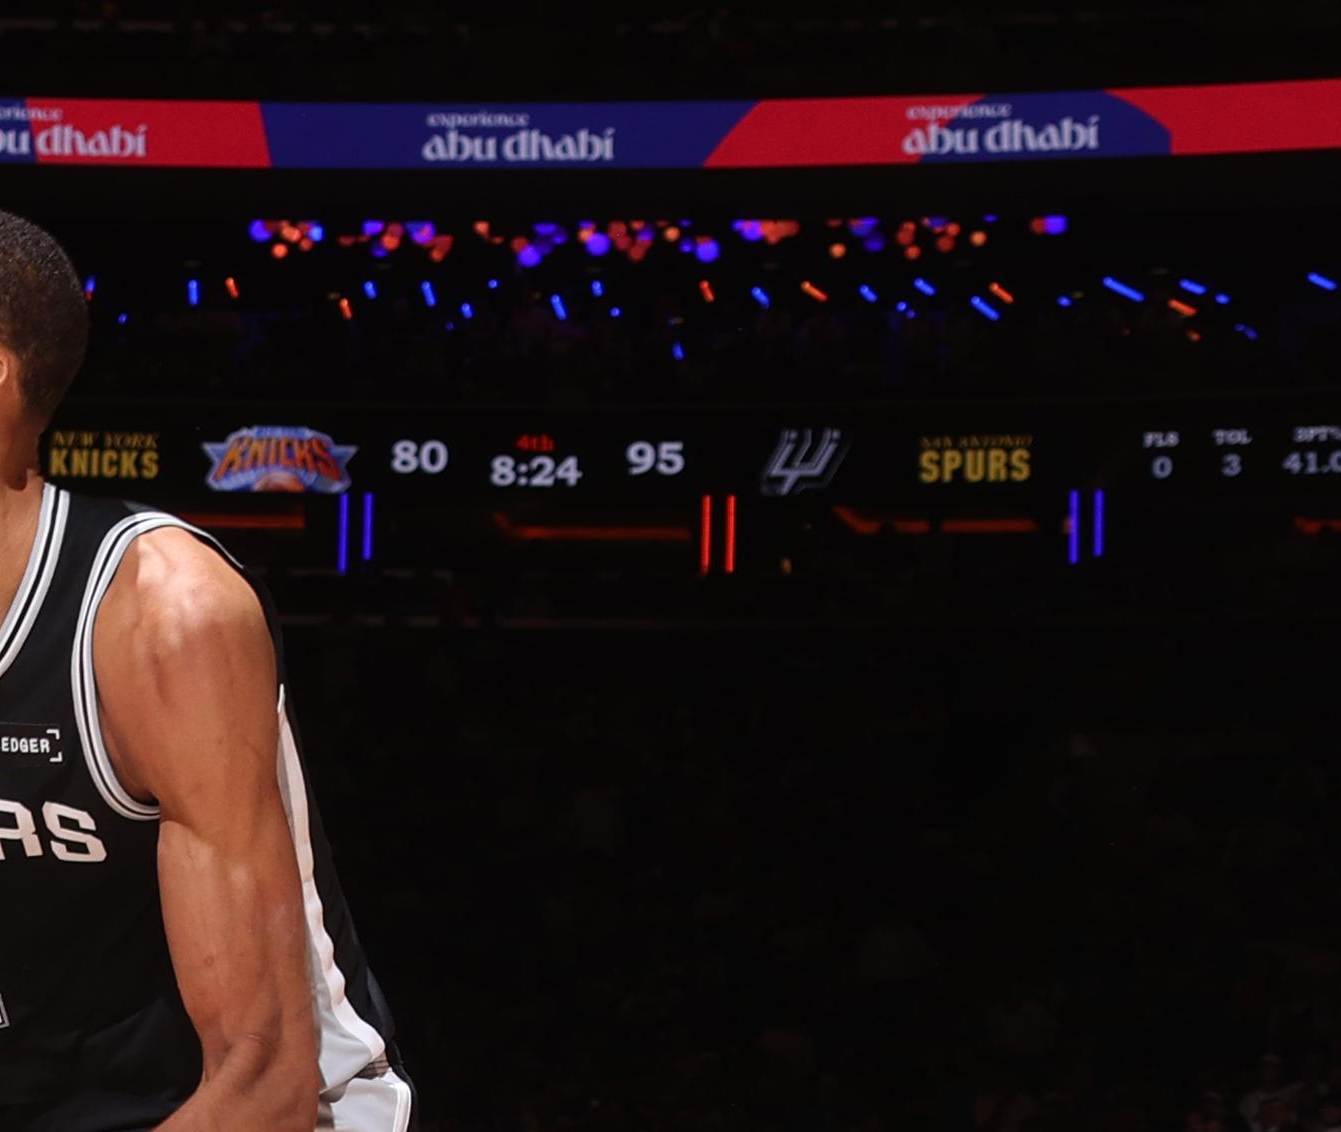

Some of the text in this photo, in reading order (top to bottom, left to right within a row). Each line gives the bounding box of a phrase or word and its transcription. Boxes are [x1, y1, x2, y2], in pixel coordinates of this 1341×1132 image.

[426, 112, 529, 128] experience
[906, 103, 1012, 121] experience
[37, 124, 147, 157] dhabi
[422, 127, 615, 162] abu dhabi
[902, 115, 1099, 155] abu dhabi
[54, 431, 158, 449] NEW YORK
[516, 434, 555, 452] 4th
[1143, 431, 1180, 448] FLS
[1213, 429, 1253, 445] TOL
[50, 448, 159, 479] KNICKS
[214, 436, 342, 481] KNICKS
[391, 440, 448, 474] 80
[490, 456, 583, 487] 8:24
[626, 441, 685, 475] 95
[919, 449, 1031, 482] SPURS
[1151, 456, 1173, 479] 0
[1222, 453, 1242, 477] 3
